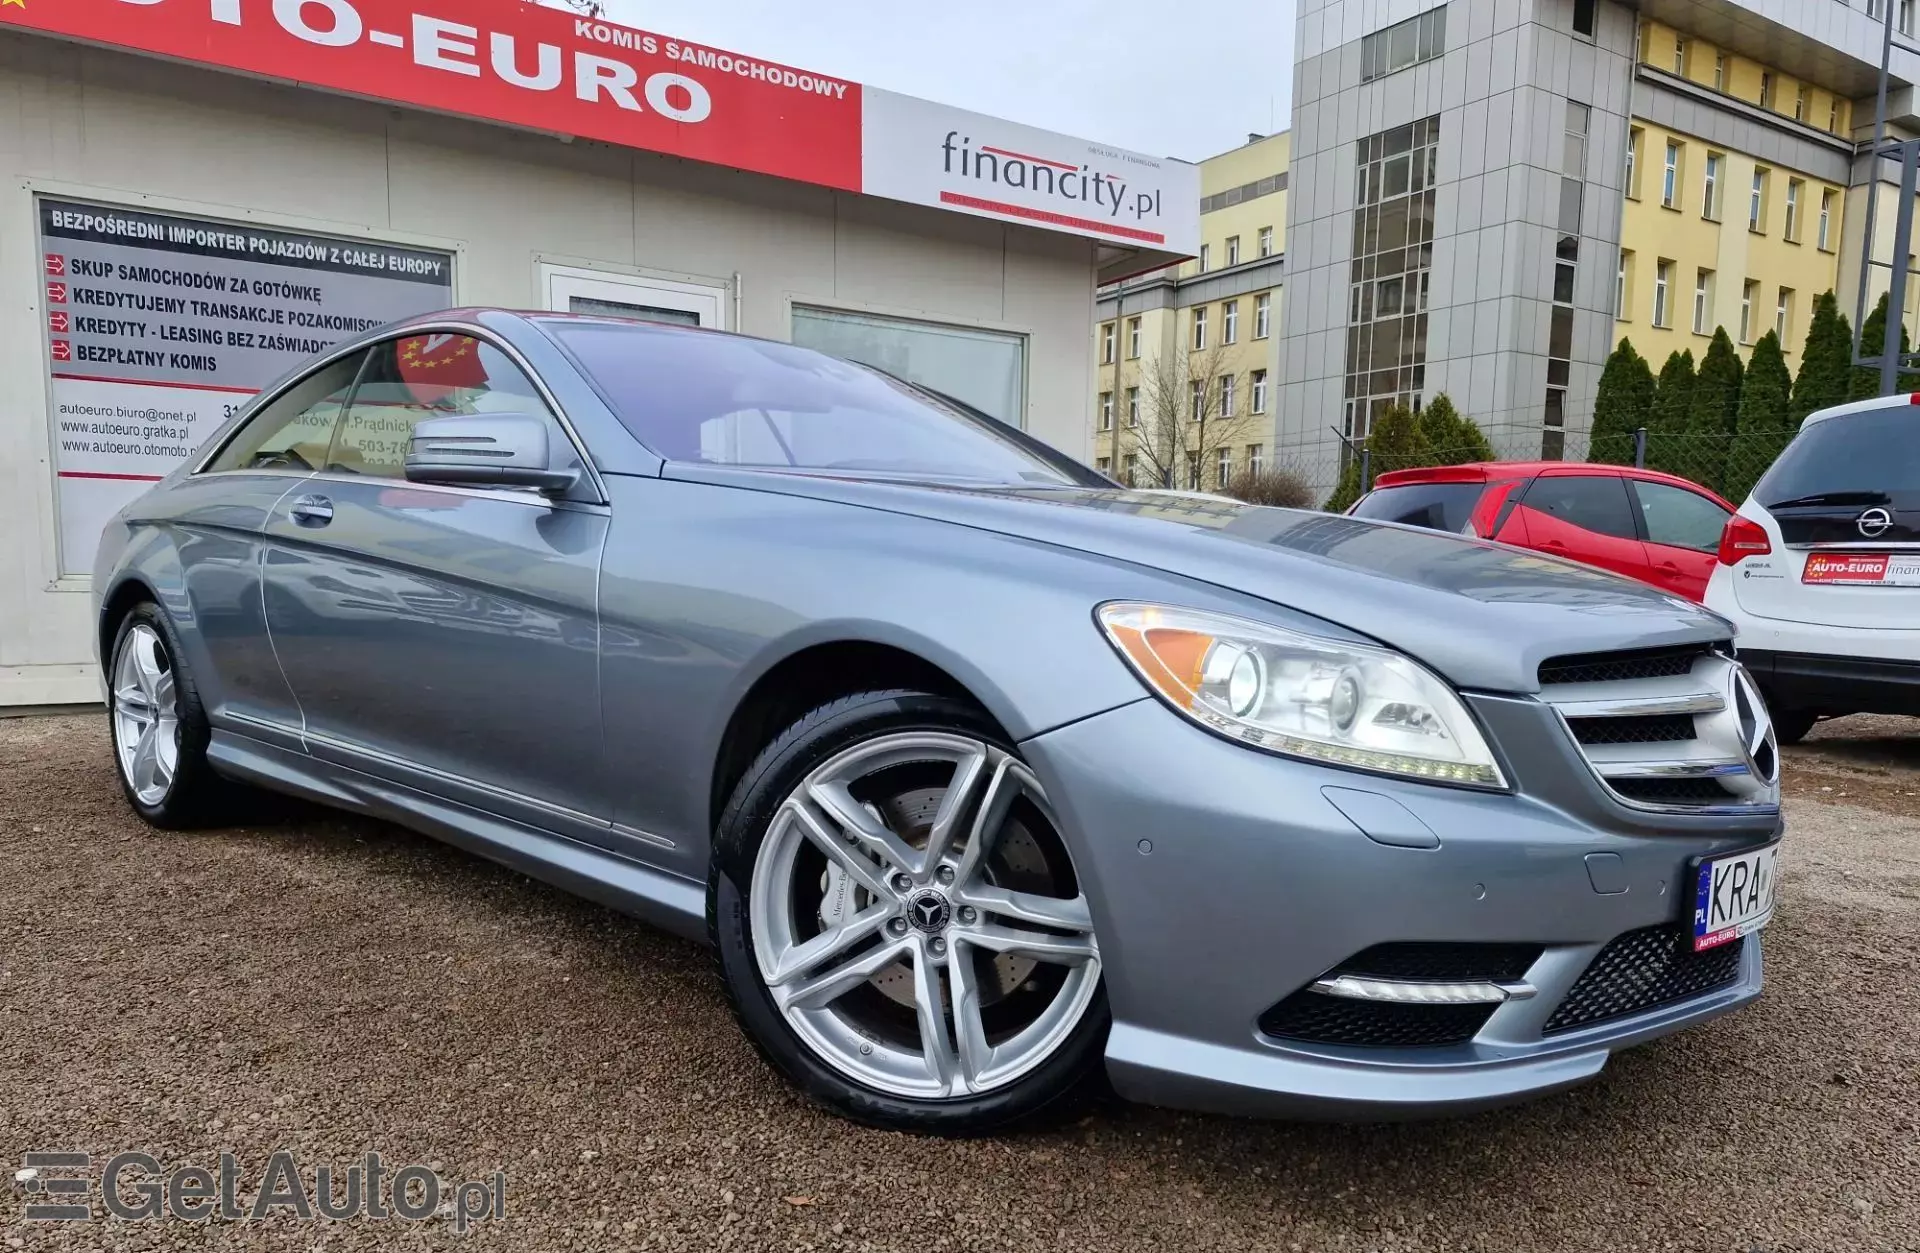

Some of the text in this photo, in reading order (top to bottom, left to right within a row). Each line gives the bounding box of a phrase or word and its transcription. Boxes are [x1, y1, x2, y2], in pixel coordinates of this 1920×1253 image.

[575, 19, 849, 100] KOMIS SAMOCHODOWY
[941, 131, 1161, 219] financity.pl
[52, 210, 441, 276] BEZPOŚREDNI IMPORTER POJAZDÓW Z CAŁEJ EUROPY
[71, 258, 322, 305] SKUP SAMOCHODÓW ZA GOTÓWKĘ
[73, 287, 186, 314] KREDYTUJEMY
[190, 301, 284, 325] TRANSAKCJE
[75, 316, 147, 338] KREDYTY
[160, 325, 223, 346] LEASING
[227, 331, 255, 348] BEZ
[258, 333, 336, 353] ZAŚWIADC
[77, 345, 217, 372] BEZPŁATNY KOMIS
[59, 403, 197, 424] autoeuro.biuro@onet.pl
[61, 420, 189, 441] www.autoeuro.gratka.pl
[62, 439, 199, 458] www.autoeuro.otomoto.p
[1812, 563, 1883, 573] AUTO-EURO
[1710, 856, 1761, 926] KRA
[1695, 909, 1706, 926] PL
[1699, 930, 1735, 948] AUTO-EURO
